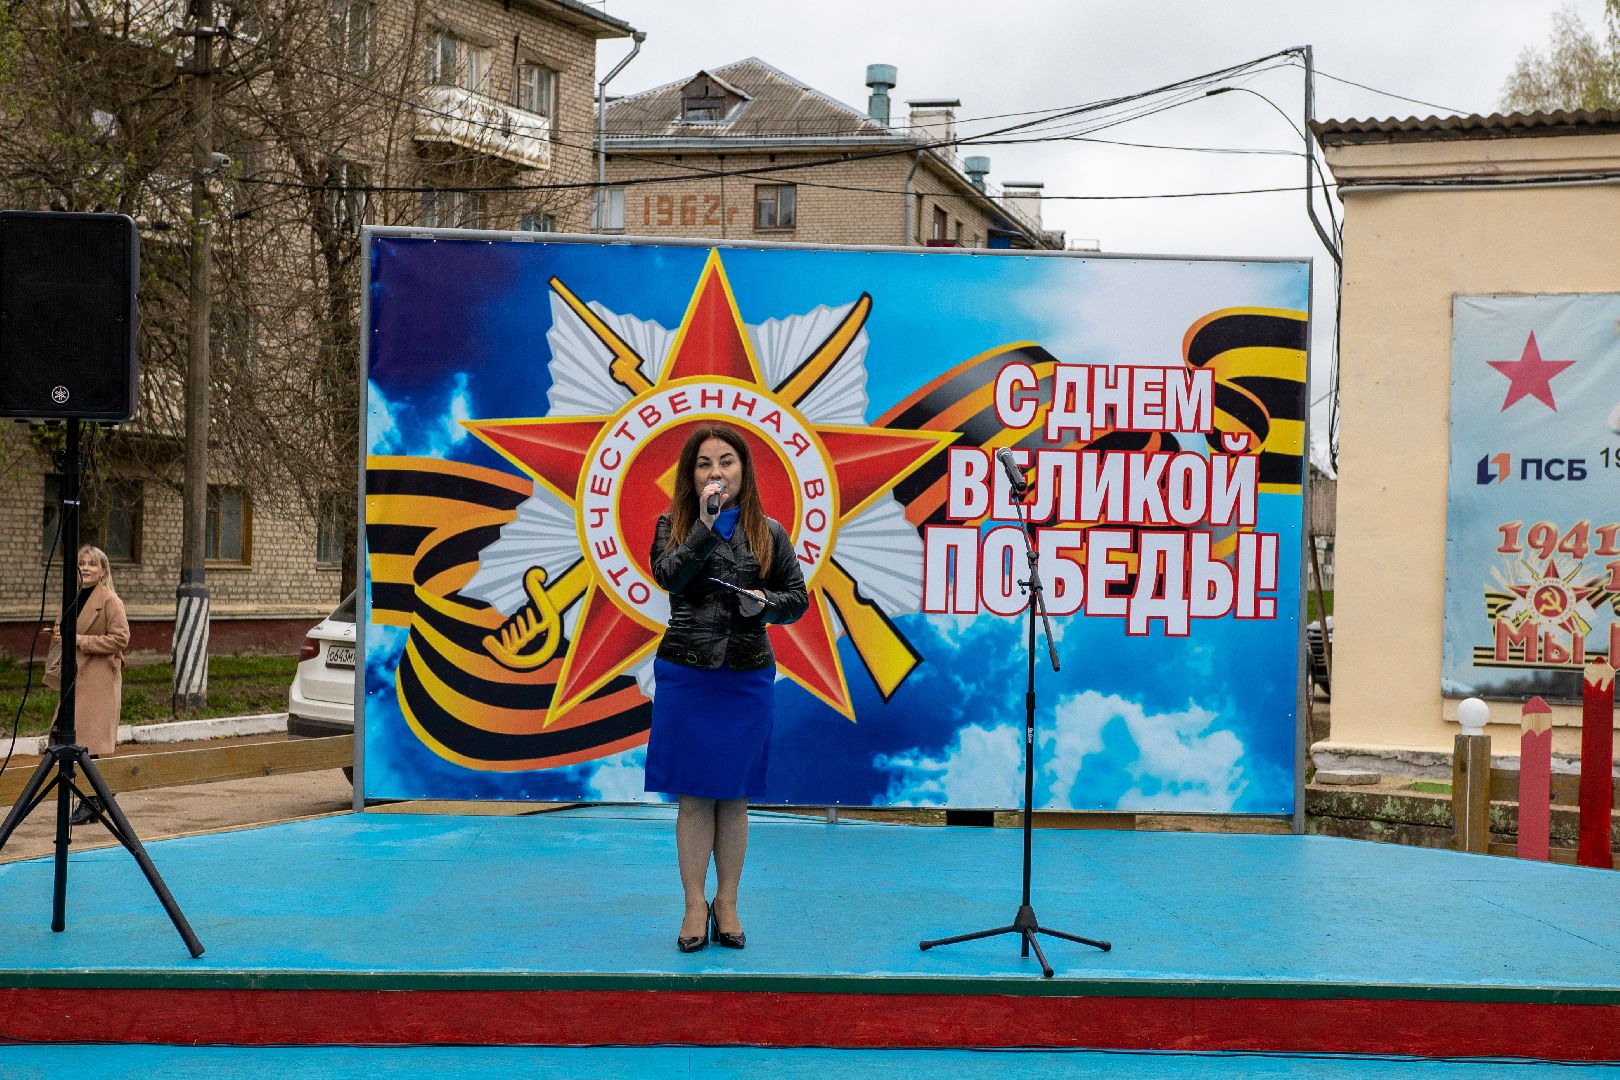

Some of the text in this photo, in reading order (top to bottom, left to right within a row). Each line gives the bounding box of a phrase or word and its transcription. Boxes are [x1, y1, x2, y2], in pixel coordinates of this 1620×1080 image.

[994, 361, 1215, 443] С ДНЕМ
[590, 388, 827, 605] ОТЕЧЕСТВЕННАЯ ВОЙ
[946, 432, 1259, 527] ВЕЛИКОЙ
[1521, 458, 1587, 481] ПСБ
[922, 524, 1279, 637] ПОБЕДЫ!
[1494, 617, 1585, 665] МЫ
